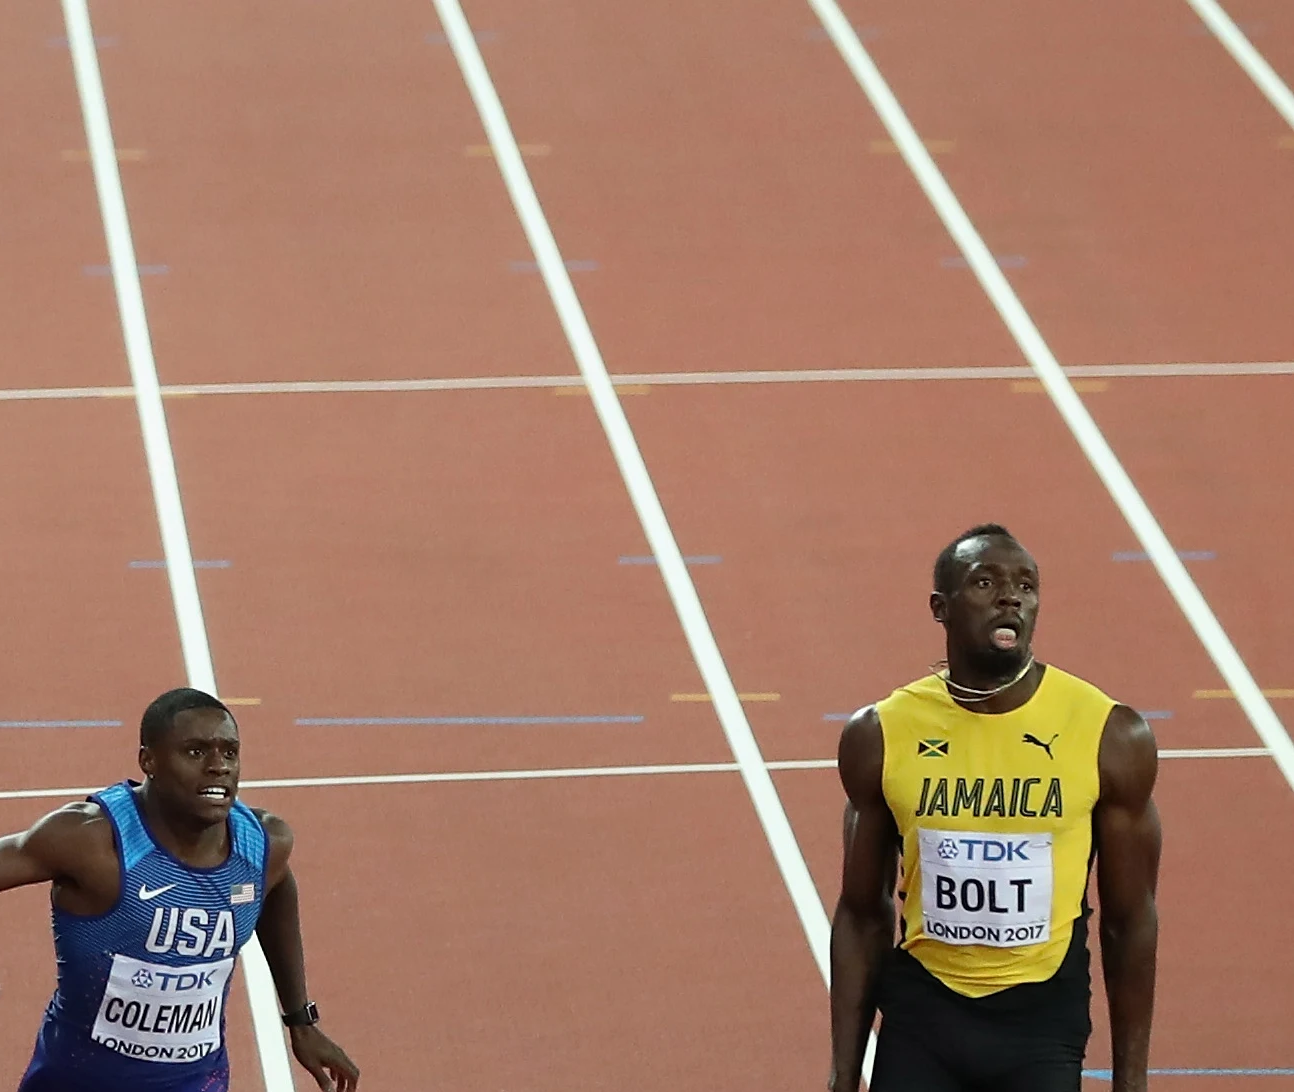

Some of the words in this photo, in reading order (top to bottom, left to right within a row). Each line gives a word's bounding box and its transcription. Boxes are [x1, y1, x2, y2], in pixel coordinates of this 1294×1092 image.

[915, 777, 1064, 818] JAMAICA
[959, 838, 1030, 862] TDK
[935, 874, 1033, 914] BOLT
[145, 907, 237, 958] USA
[926, 920, 1000, 942] LONDON
[1004, 924, 1046, 943] 2017
[155, 968, 218, 992] TDK
[104, 995, 219, 1035] COLEMAN
[175, 1042, 214, 1060] 2017
